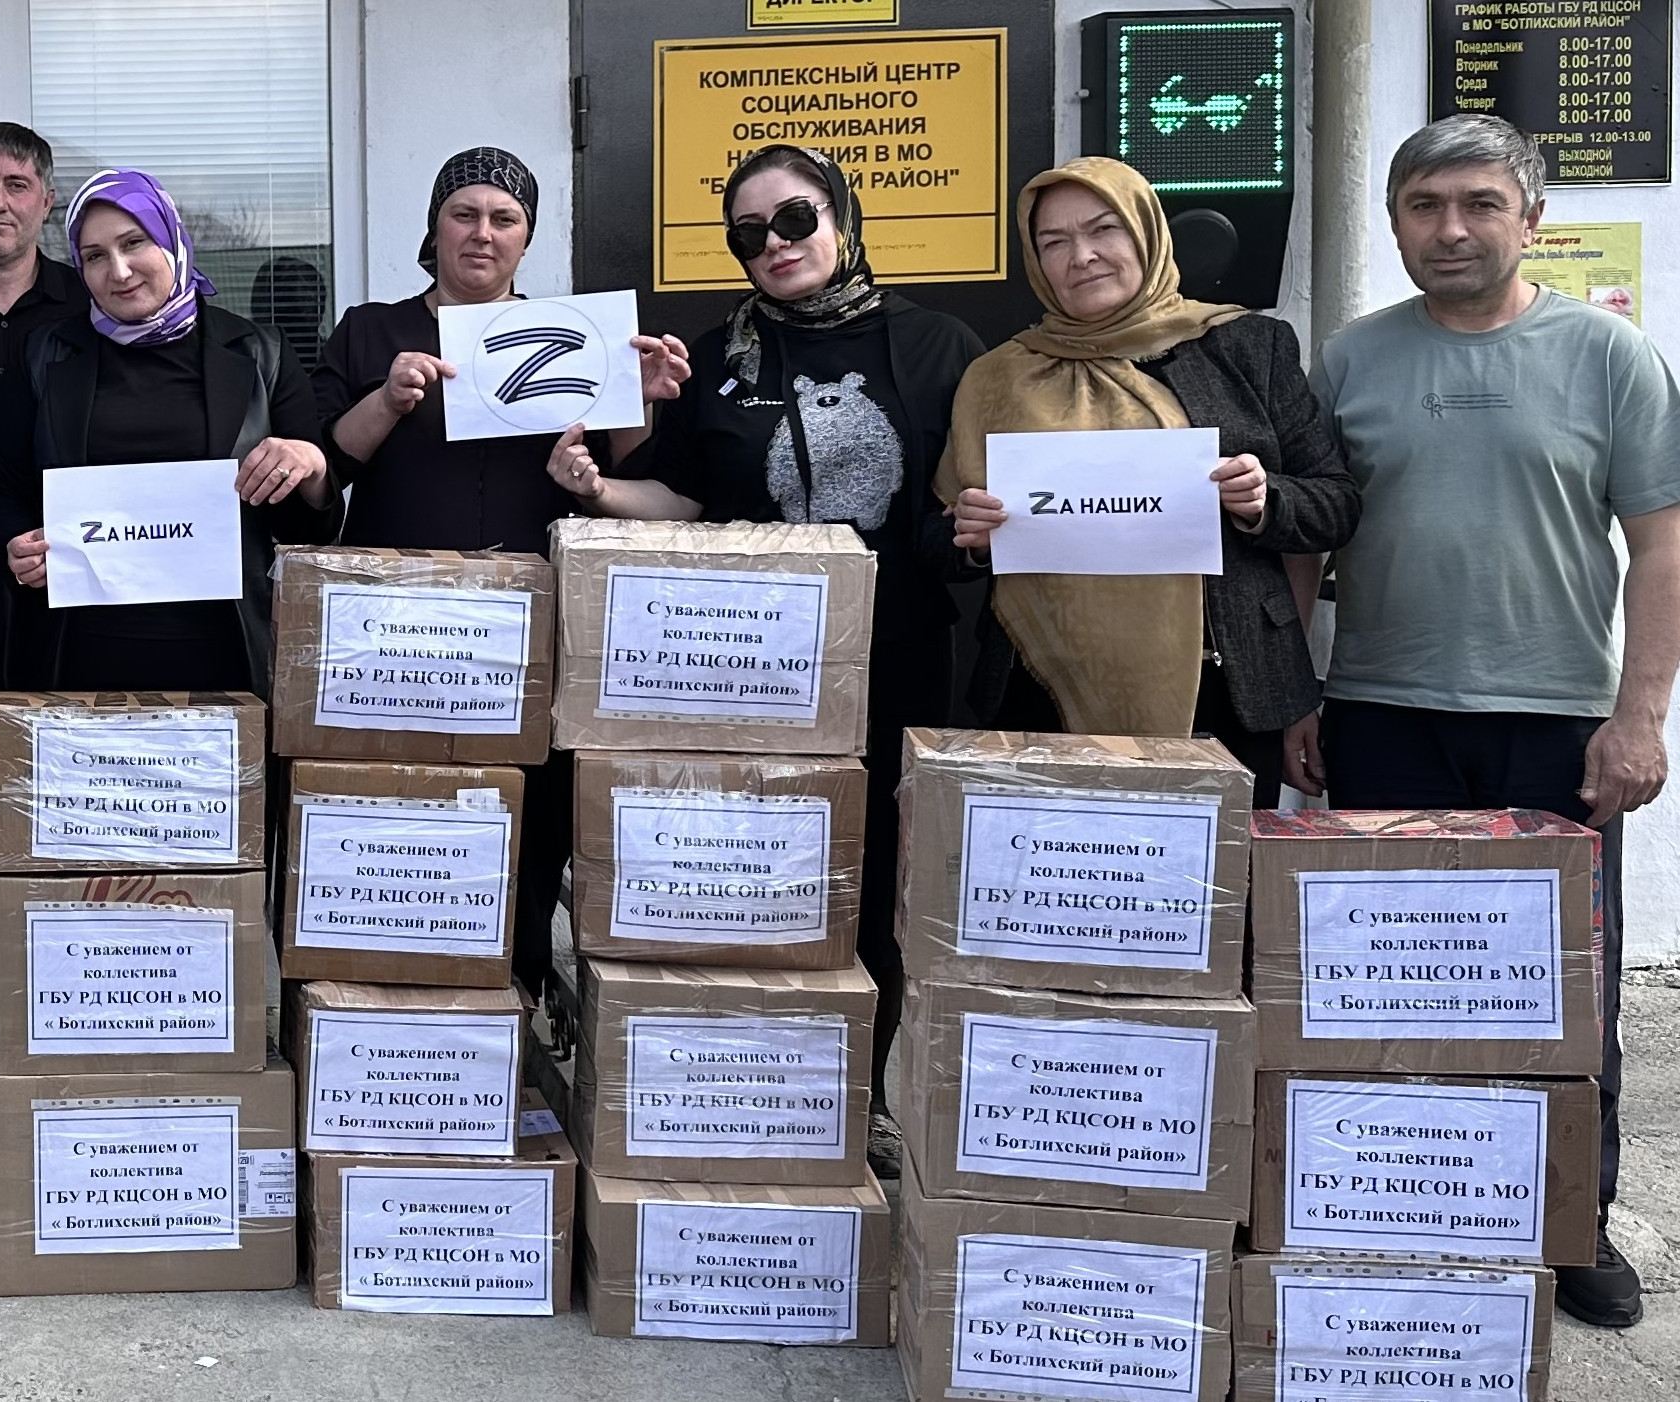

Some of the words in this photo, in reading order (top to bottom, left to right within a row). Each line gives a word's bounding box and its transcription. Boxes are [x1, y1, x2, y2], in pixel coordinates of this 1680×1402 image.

[1455, 3, 1502, 16] ГРАФИК
[1505, 1, 1556, 14] РАБОТЫ
[1558, 1, 1580, 13] ГБУ
[1582, 1, 1598, 14] РД
[1600, 0, 1641, 14] КЦСОН
[1462, 22, 1470, 31] в
[1472, 19, 1492, 30] МО
[1455, 40, 1524, 56] Понедельник
[1559, 36, 1632, 52] 8.00-17.00
[1456, 58, 1499, 74] Вторник
[1559, 53, 1632, 69] 8.00-17.00
[699, 61, 878, 89] КОМПЛЕКСНЫЙ
[885, 62, 961, 85] ЦЕНТР
[1455, 75, 1487, 93] Среда
[1559, 71, 1631, 87] 8.00-17.00
[741, 90, 918, 116] СОЦИАЛЬНОГО
[1455, 95, 1496, 111] Четверг
[1559, 91, 1631, 107] 8.00-17.00
[1559, 108, 1631, 124] 8.00-17.00
[733, 116, 926, 141] ОБСЛУЖИВАНИЯ
[1533, 133, 1583, 144] ЕРЕРЫВ
[1590, 131, 1651, 142] 12.00-13.00
[875, 147, 889, 162] В
[897, 144, 932, 161] МО
[1559, 147, 1612, 161] ВЫХОДНОЙ
[1560, 163, 1613, 178] ВЫХОДНОЙ
[1081, 497, 1163, 514] НАШИХ
[124, 522, 194, 540] НАШИХ
[647, 601, 660, 614] С
[665, 605, 759, 620] уважением
[764, 611, 783, 621] от
[663, 629, 763, 644] коллектива
[614, 649, 651, 663] ГБУ
[656, 651, 681, 668] РД
[685, 653, 756, 670] КЦСОН
[761, 661, 771, 670] в
[776, 658, 809, 672] МО
[633, 675, 734, 693] Ботлихский
[340, 839, 353, 852] С
[358, 843, 447, 857] уважением
[452, 848, 470, 858] от
[1011, 835, 1026, 850] С
[1031, 840, 1139, 856] уважением
[1146, 846, 1167, 857] от
[356, 867, 451, 880] коллектива
[1030, 866, 1145, 882] коллектива
[310, 885, 346, 899] ГБУ
[350, 887, 373, 903] РД
[378, 889, 446, 905] КЦСОН
[450, 896, 459, 905] в
[464, 893, 494, 906] МО
[973, 887, 1017, 904] ГБУ
[1023, 890, 1051, 909] РД
[1057, 892, 1138, 912] КЦСОН
[1144, 902, 1155, 912] в
[1160, 898, 1197, 914] МО
[328, 911, 425, 928] Ботлихский
[995, 917, 1113, 939] Ботлихский
[1336, 1119, 1351, 1134] С
[1357, 1124, 1467, 1141] уважением
[1474, 1130, 1496, 1142] от
[1356, 1151, 1474, 1168] коллектива
[1300, 1173, 1345, 1190] ГБУ
[1350, 1176, 1379, 1195] РД
[1384, 1178, 1467, 1197] КЦСОН
[1474, 1187, 1485, 1198] в
[1492, 1184, 1529, 1200] МО
[1324, 1204, 1443, 1225] Ботлихский
